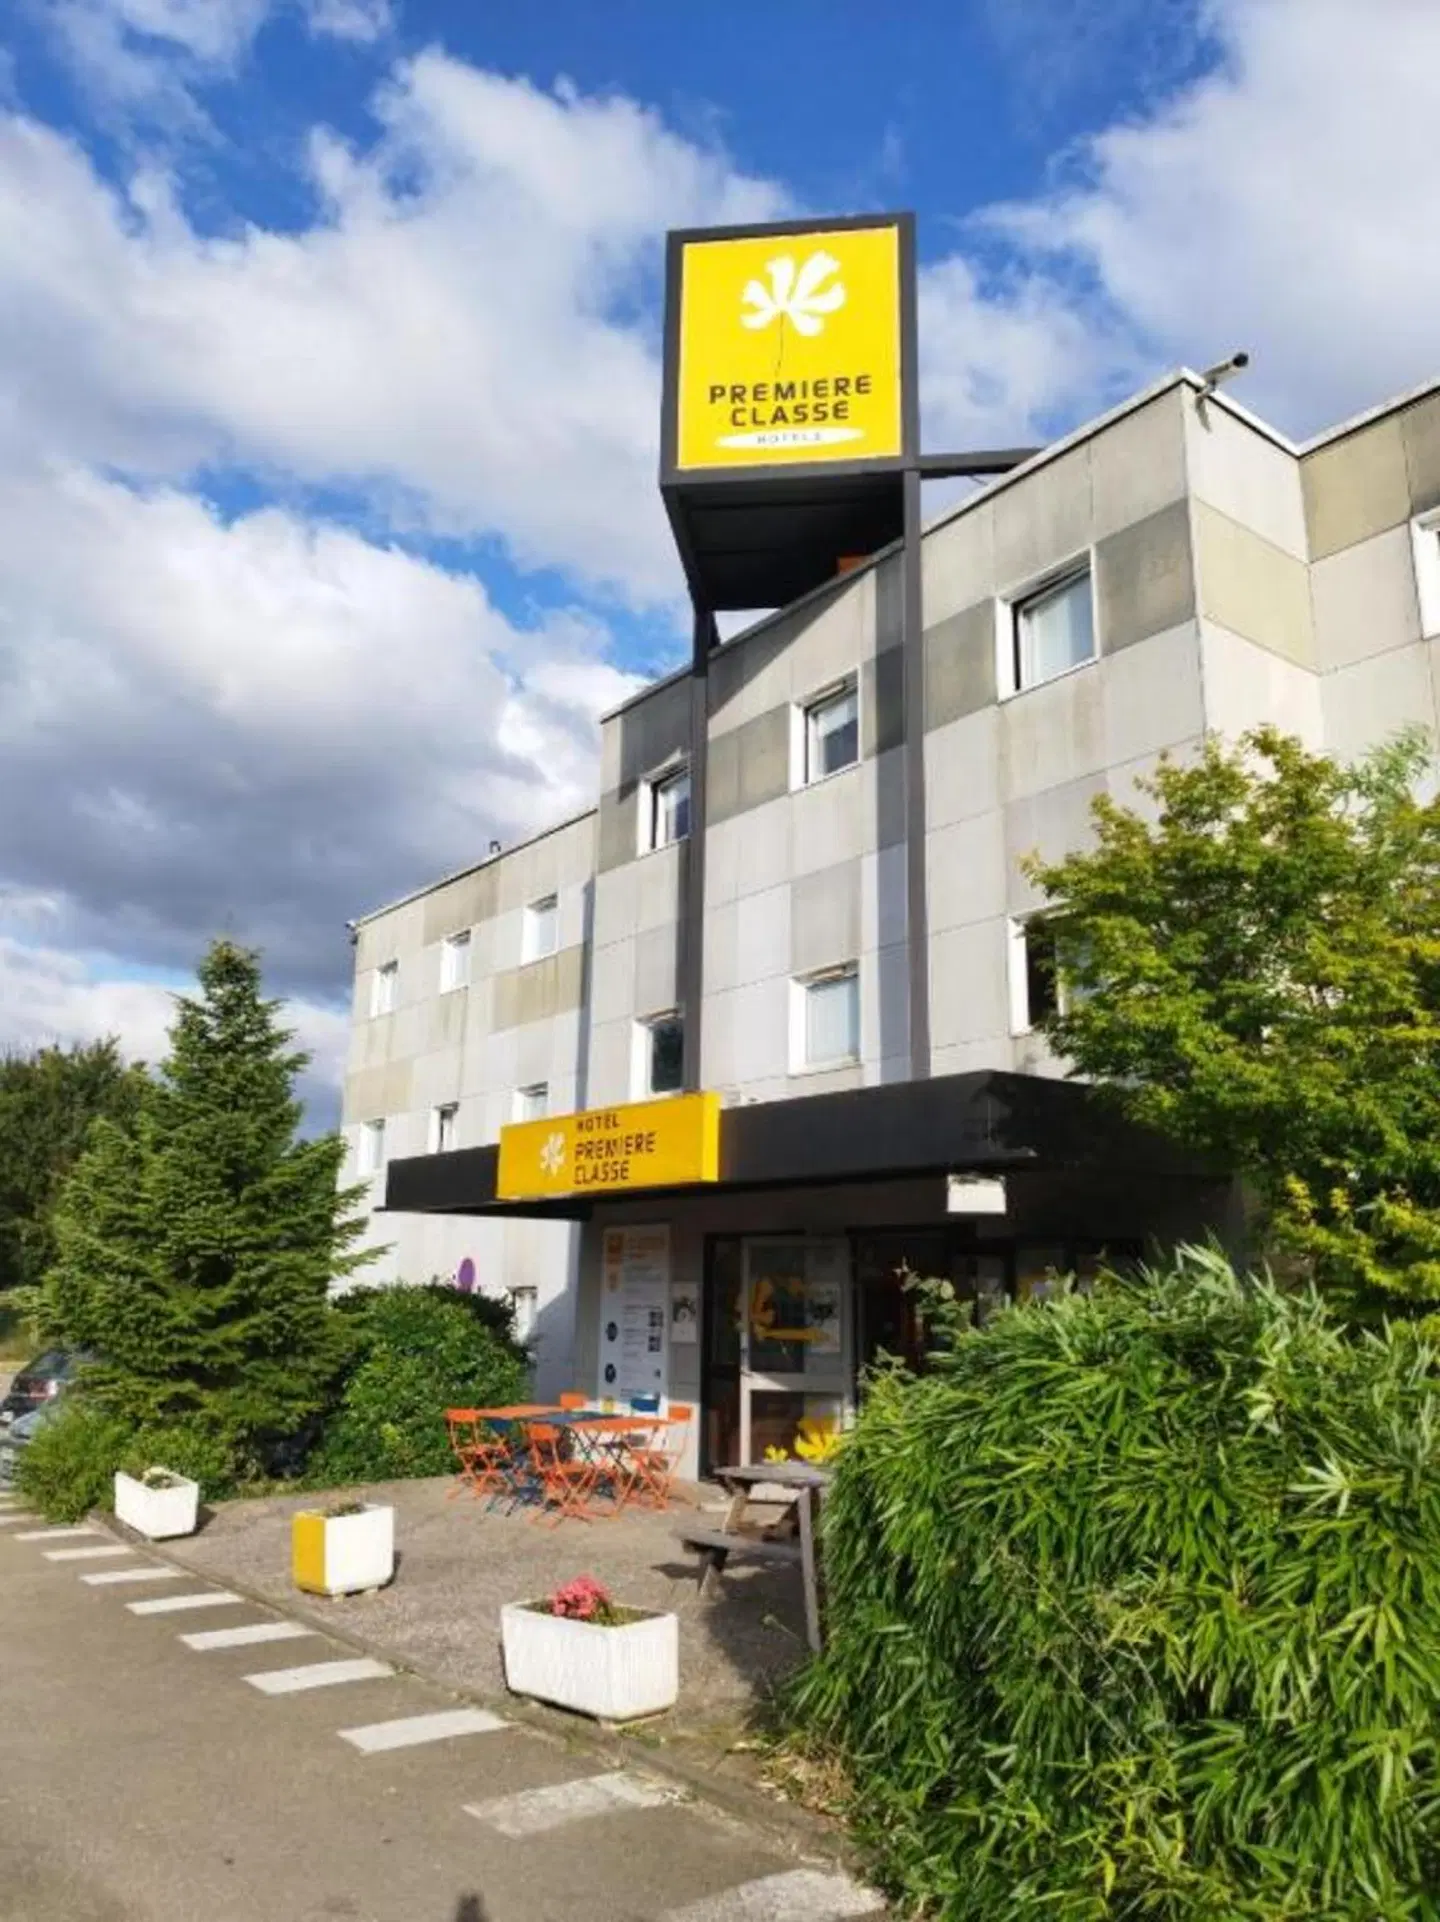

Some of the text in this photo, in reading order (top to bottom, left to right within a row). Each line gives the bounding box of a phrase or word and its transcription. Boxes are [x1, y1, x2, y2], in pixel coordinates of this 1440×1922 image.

[709, 375, 872, 403] PREMIERE
[731, 401, 850, 427] CLASSE
[756, 431, 823, 445] HOTELS
[576, 1112, 621, 1132] HOTEL
[574, 1131, 657, 1161] PREMIERE
[573, 1160, 630, 1185] CLASSE
